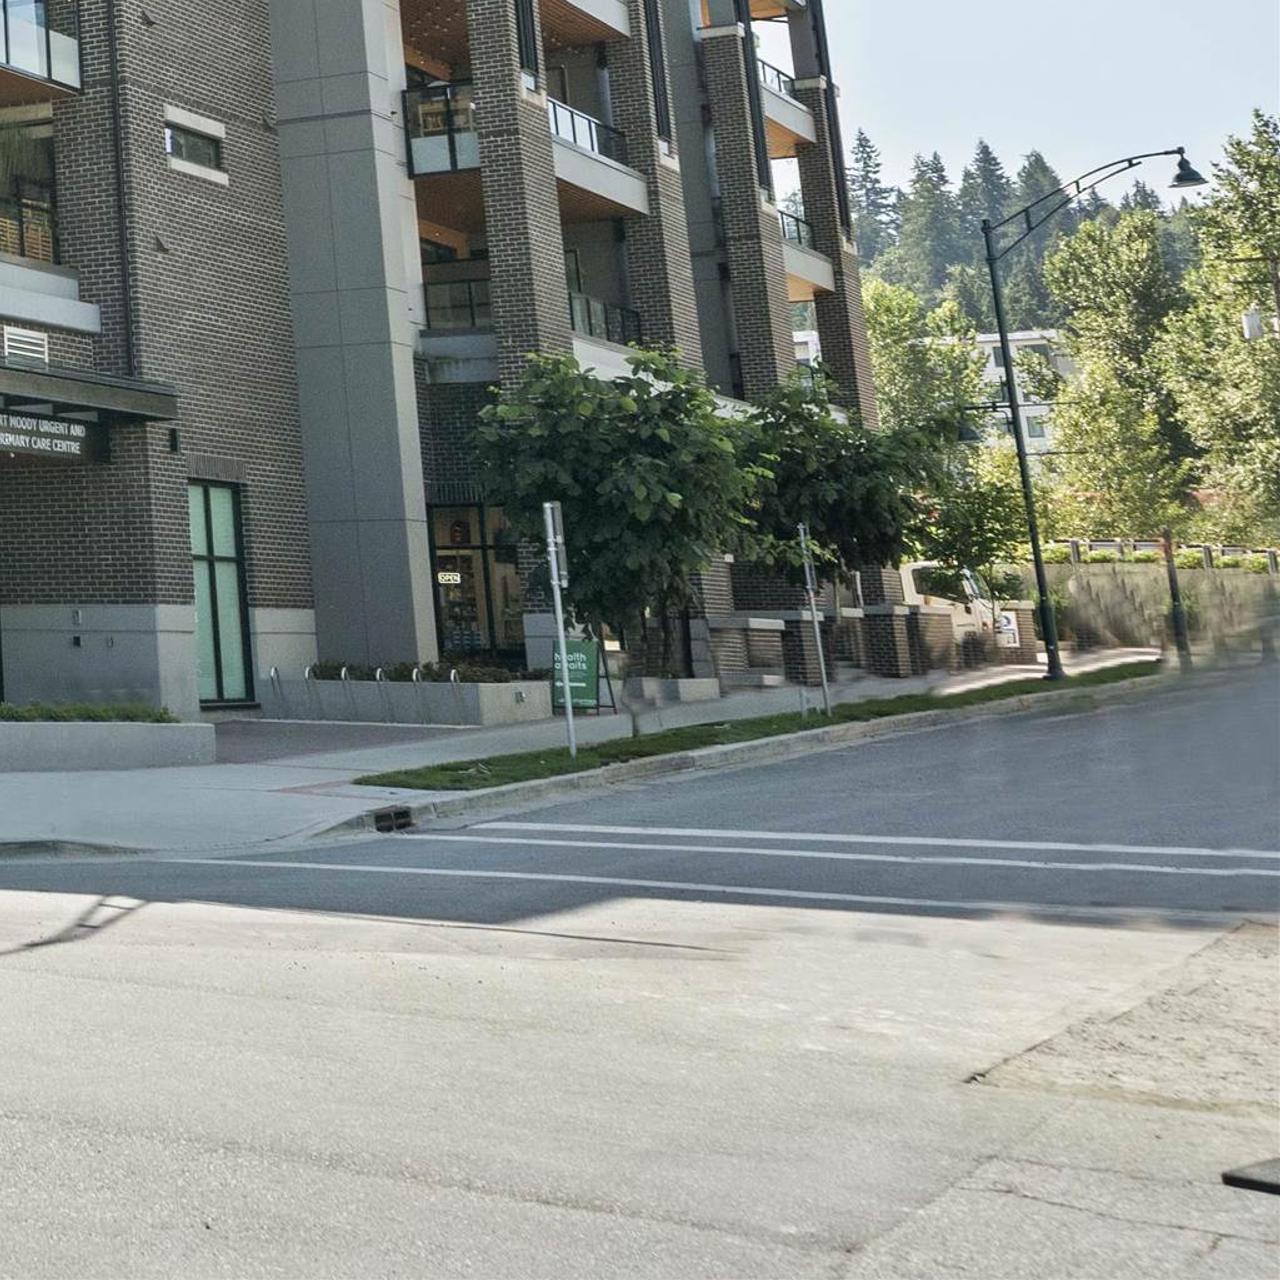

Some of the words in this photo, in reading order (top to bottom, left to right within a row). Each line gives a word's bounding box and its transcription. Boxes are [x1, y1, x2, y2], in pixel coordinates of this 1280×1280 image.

[9, 415, 38, 431] MOODY
[39, 419, 69, 435] URGENT
[70, 424, 86, 437] AND
[31, 436, 51, 451] CARE
[52, 439, 81, 455] CENTRE
[554, 652, 587, 661] halth
[554, 662, 587, 670] aaits
